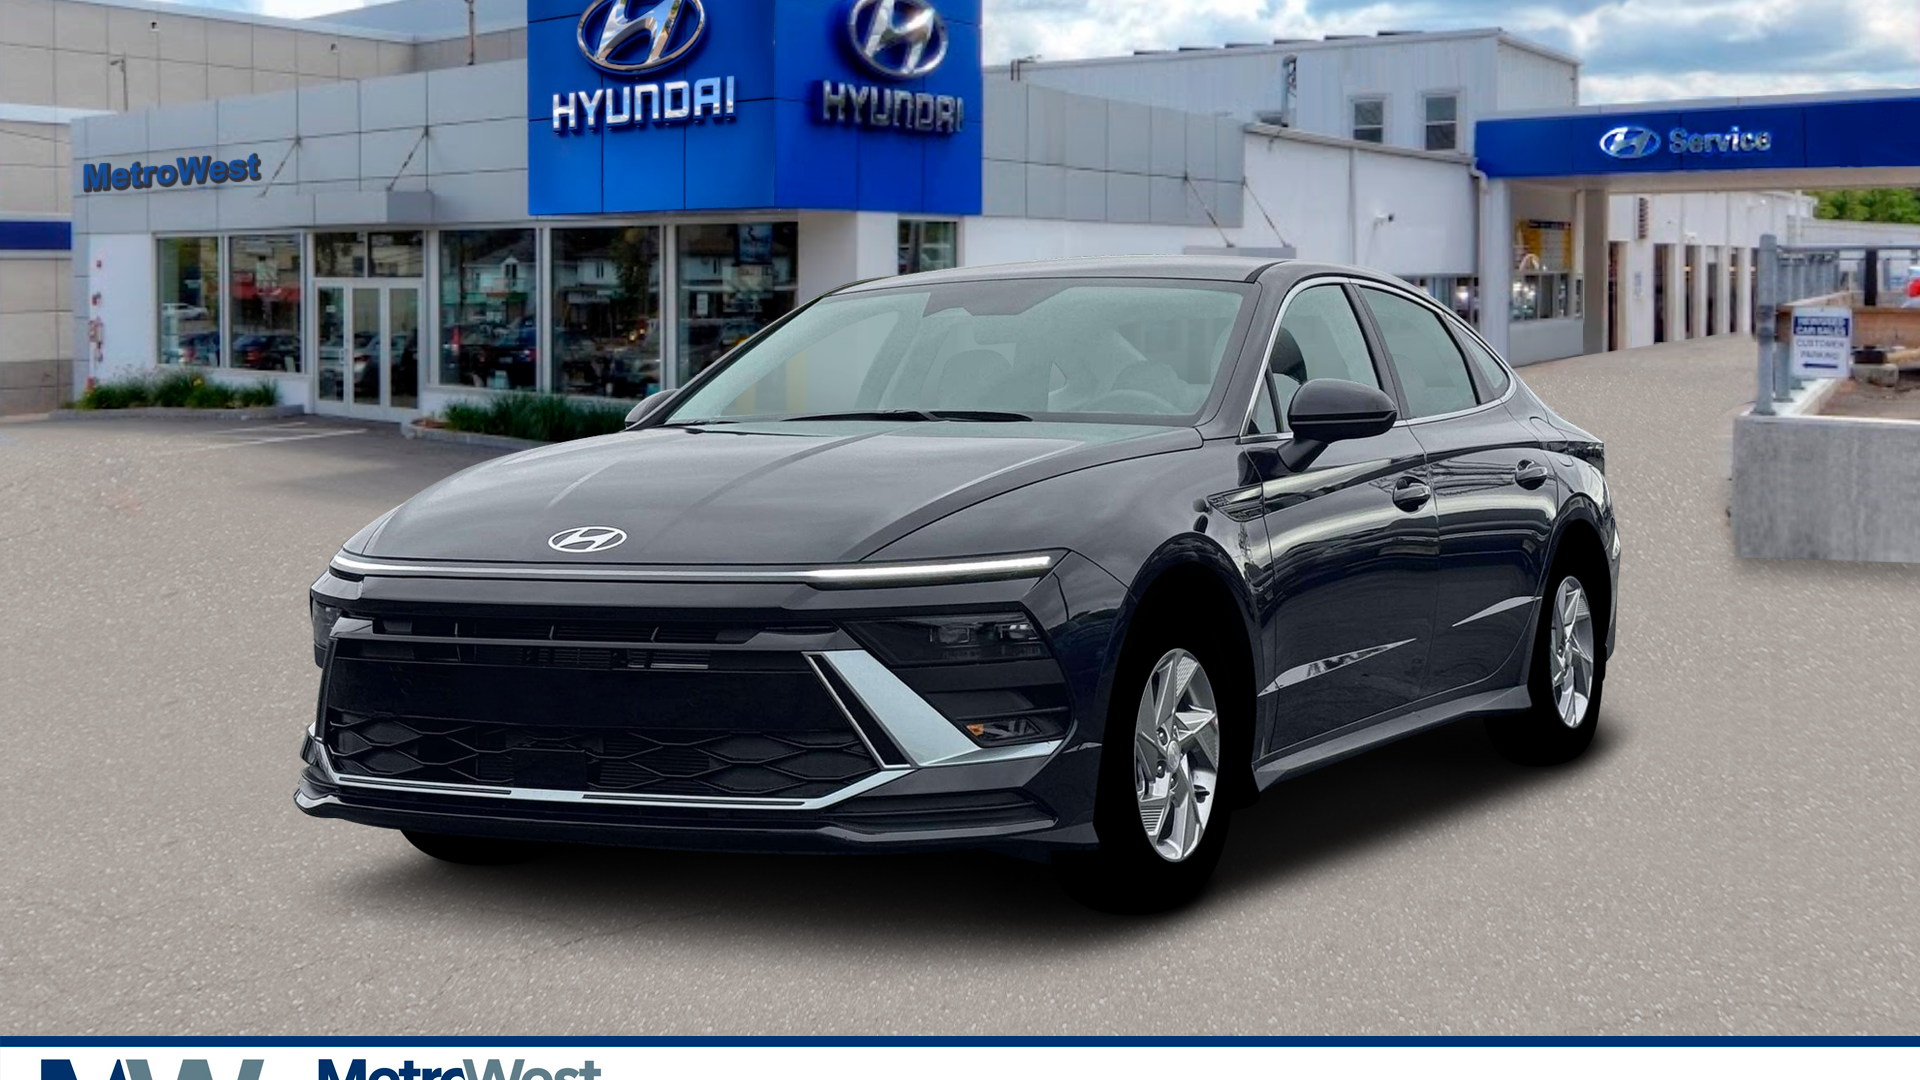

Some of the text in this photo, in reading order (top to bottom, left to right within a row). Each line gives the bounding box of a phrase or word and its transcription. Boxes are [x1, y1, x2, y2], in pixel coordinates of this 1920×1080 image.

[553, 76, 736, 132] HYUNDAI
[822, 80, 964, 133] HYUNDAI
[1669, 126, 1771, 152] Service
[83, 153, 261, 192] MetroWest
[1796, 326, 1815, 335] CAR
[1797, 339, 1844, 348] CUSTOMER
[1800, 350, 1840, 360] PARKING
